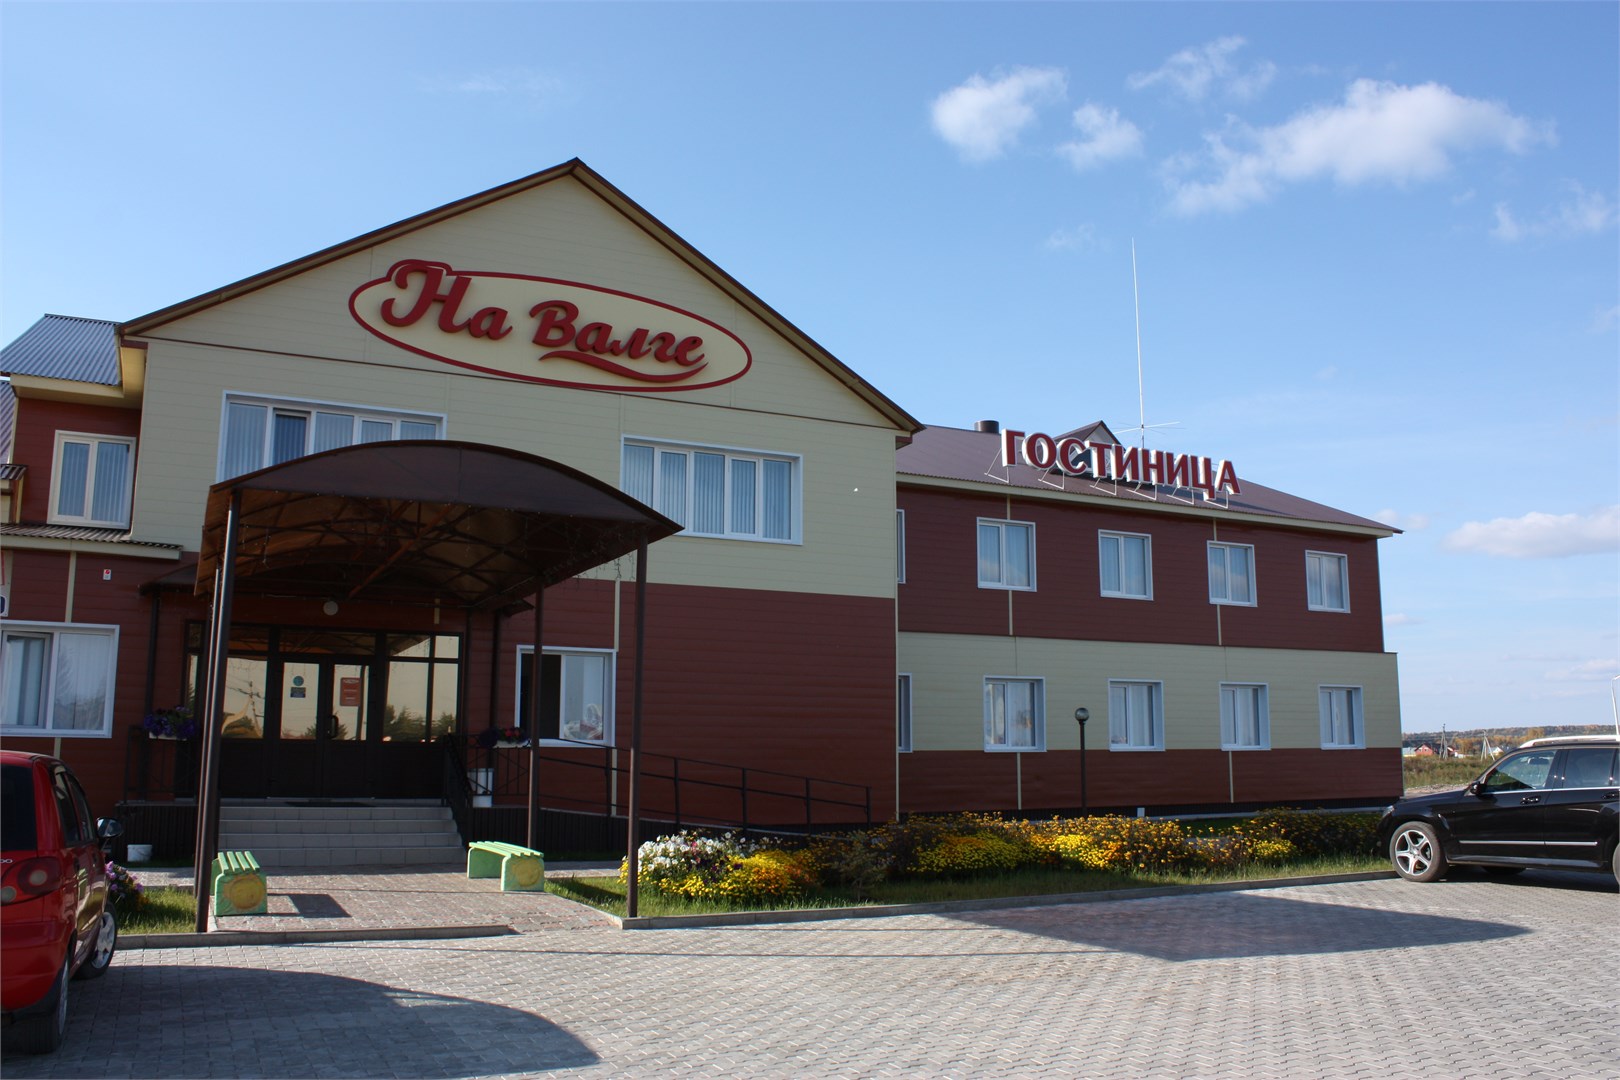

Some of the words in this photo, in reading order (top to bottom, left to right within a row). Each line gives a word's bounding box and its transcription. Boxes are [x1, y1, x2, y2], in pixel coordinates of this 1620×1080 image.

[380, 264, 512, 340] На
[529, 300, 706, 367] Валге
[1001, 429, 1241, 500] ГОСТИНИЦА
